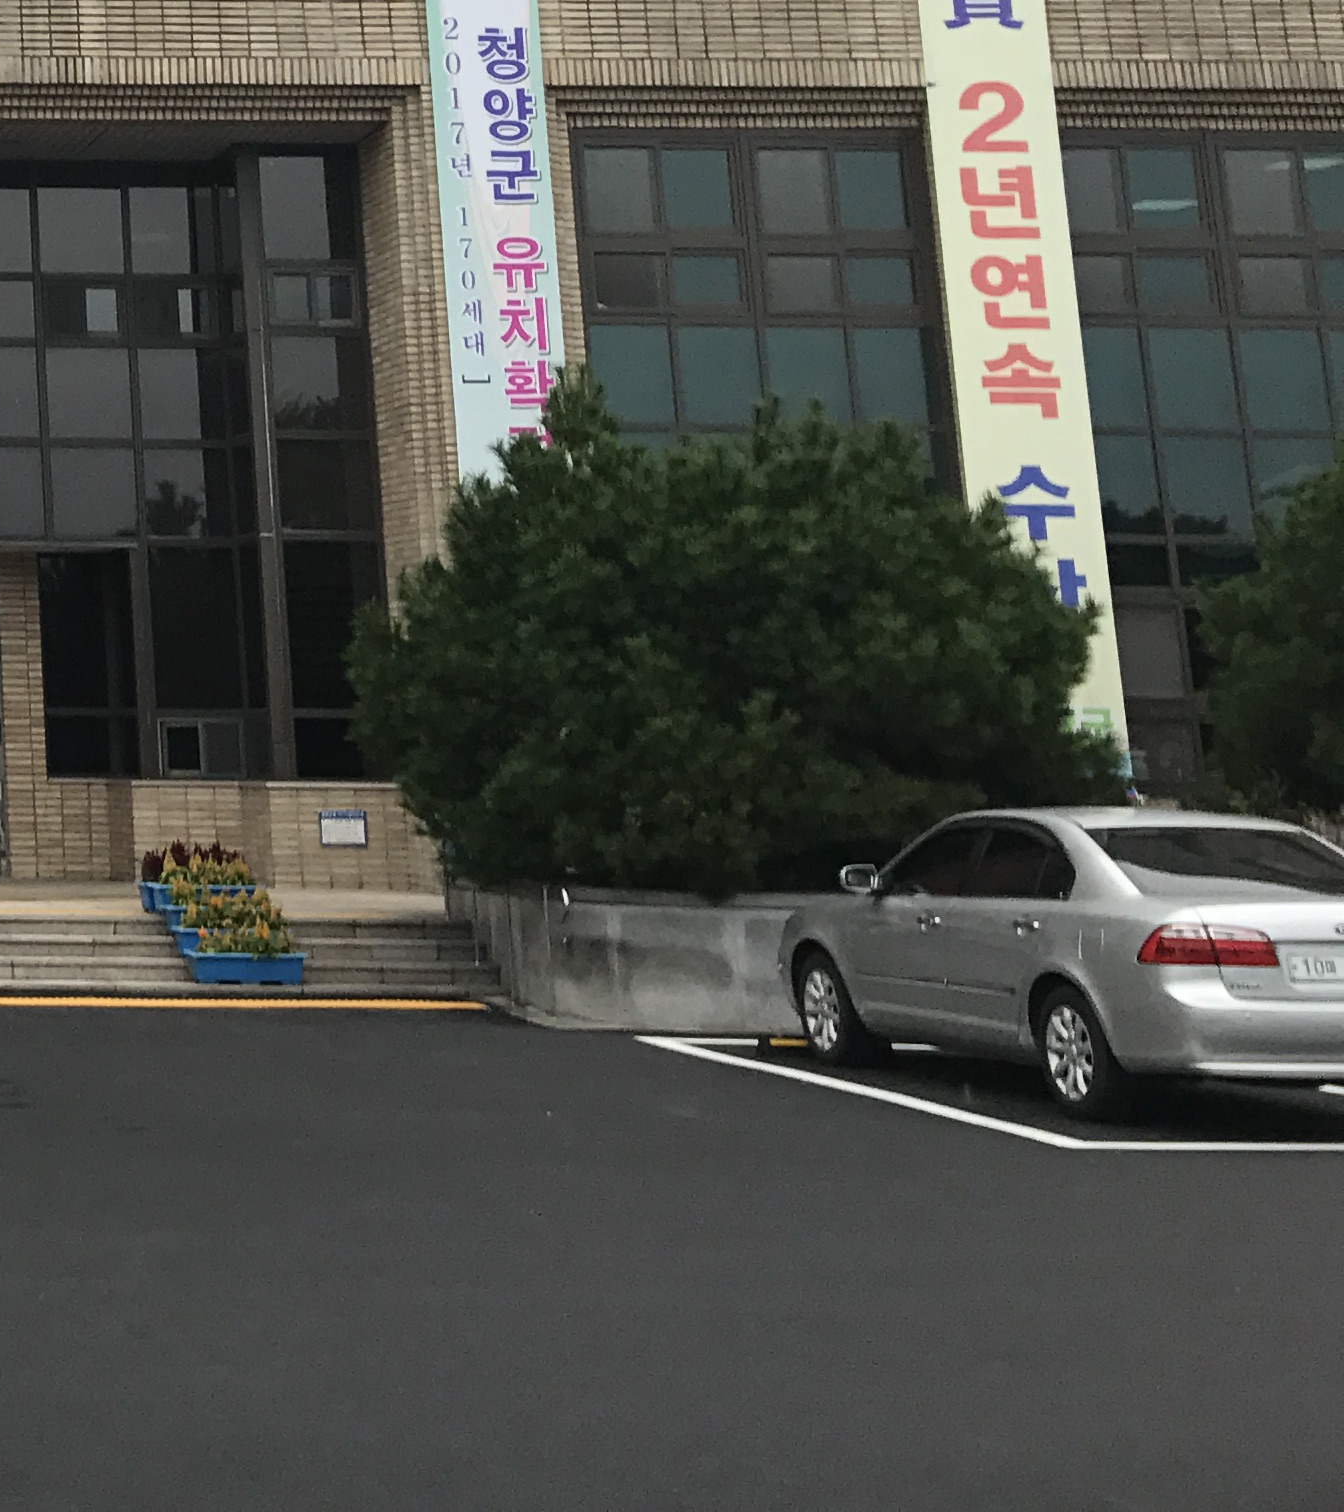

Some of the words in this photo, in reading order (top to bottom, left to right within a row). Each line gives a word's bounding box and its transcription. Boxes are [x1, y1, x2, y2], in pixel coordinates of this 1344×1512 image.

[477, 26, 539, 203] 청양군
[492, 236, 554, 448] 유치확
[958, 80, 1062, 420] 2년연속
